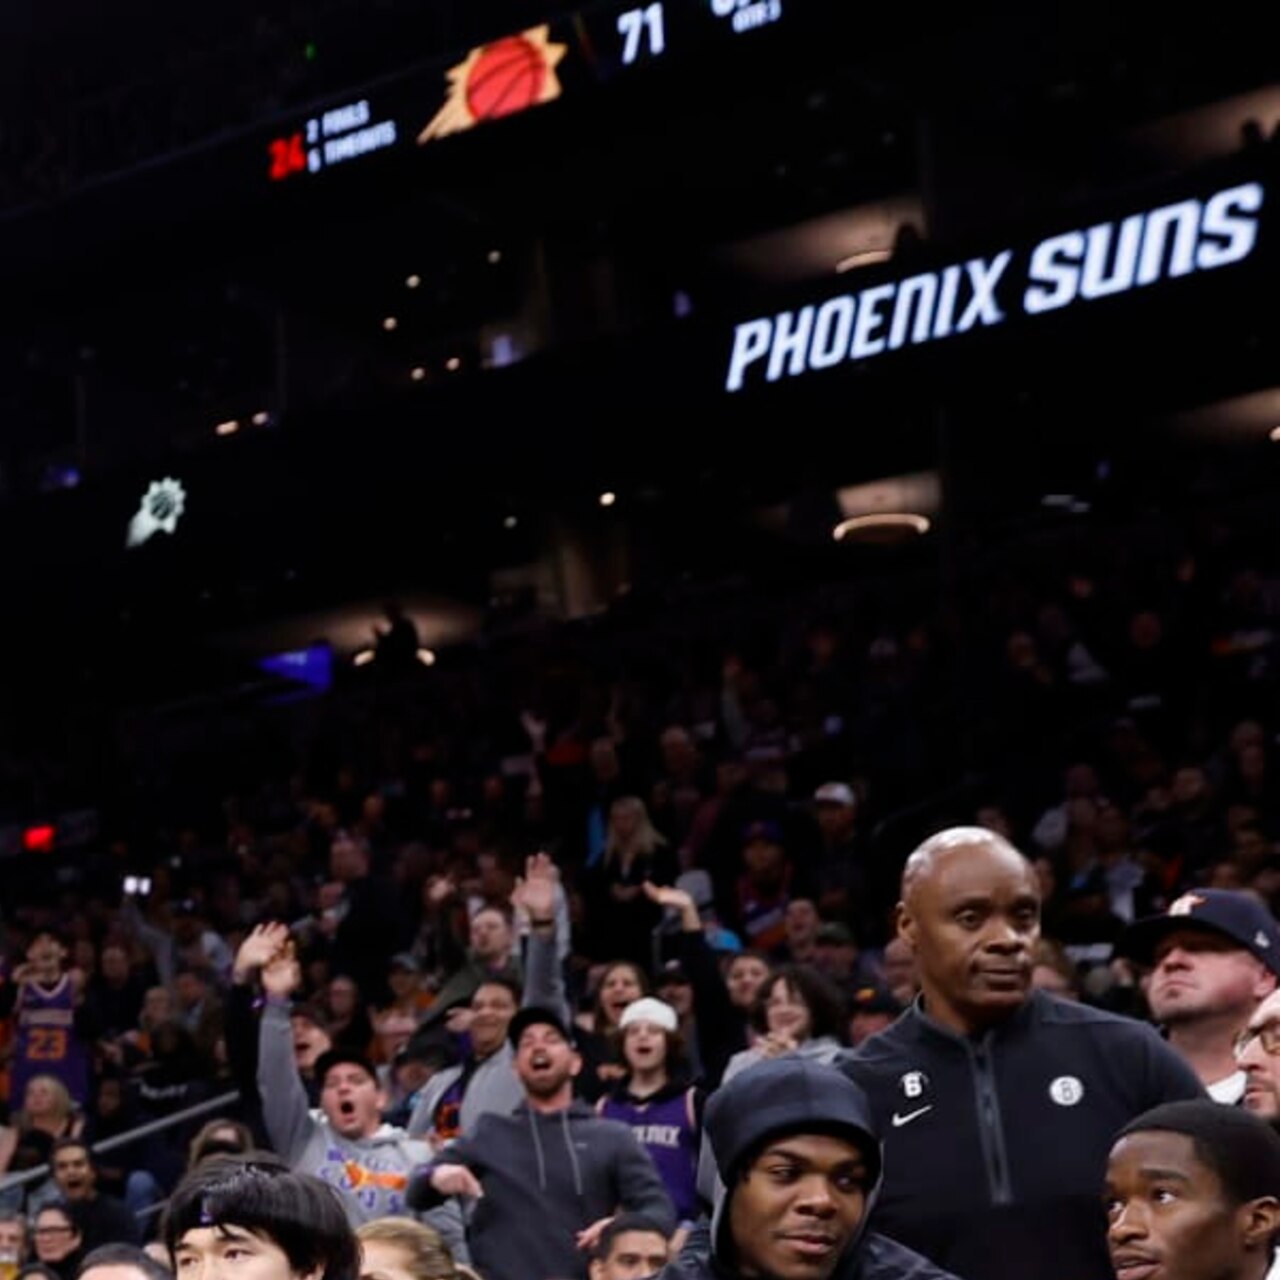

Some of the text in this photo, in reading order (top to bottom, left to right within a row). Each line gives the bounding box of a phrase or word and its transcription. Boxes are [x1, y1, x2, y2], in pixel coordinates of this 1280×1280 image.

[617, 2, 664, 64] 71
[726, 182, 1264, 392] PHOENIX SUNS
